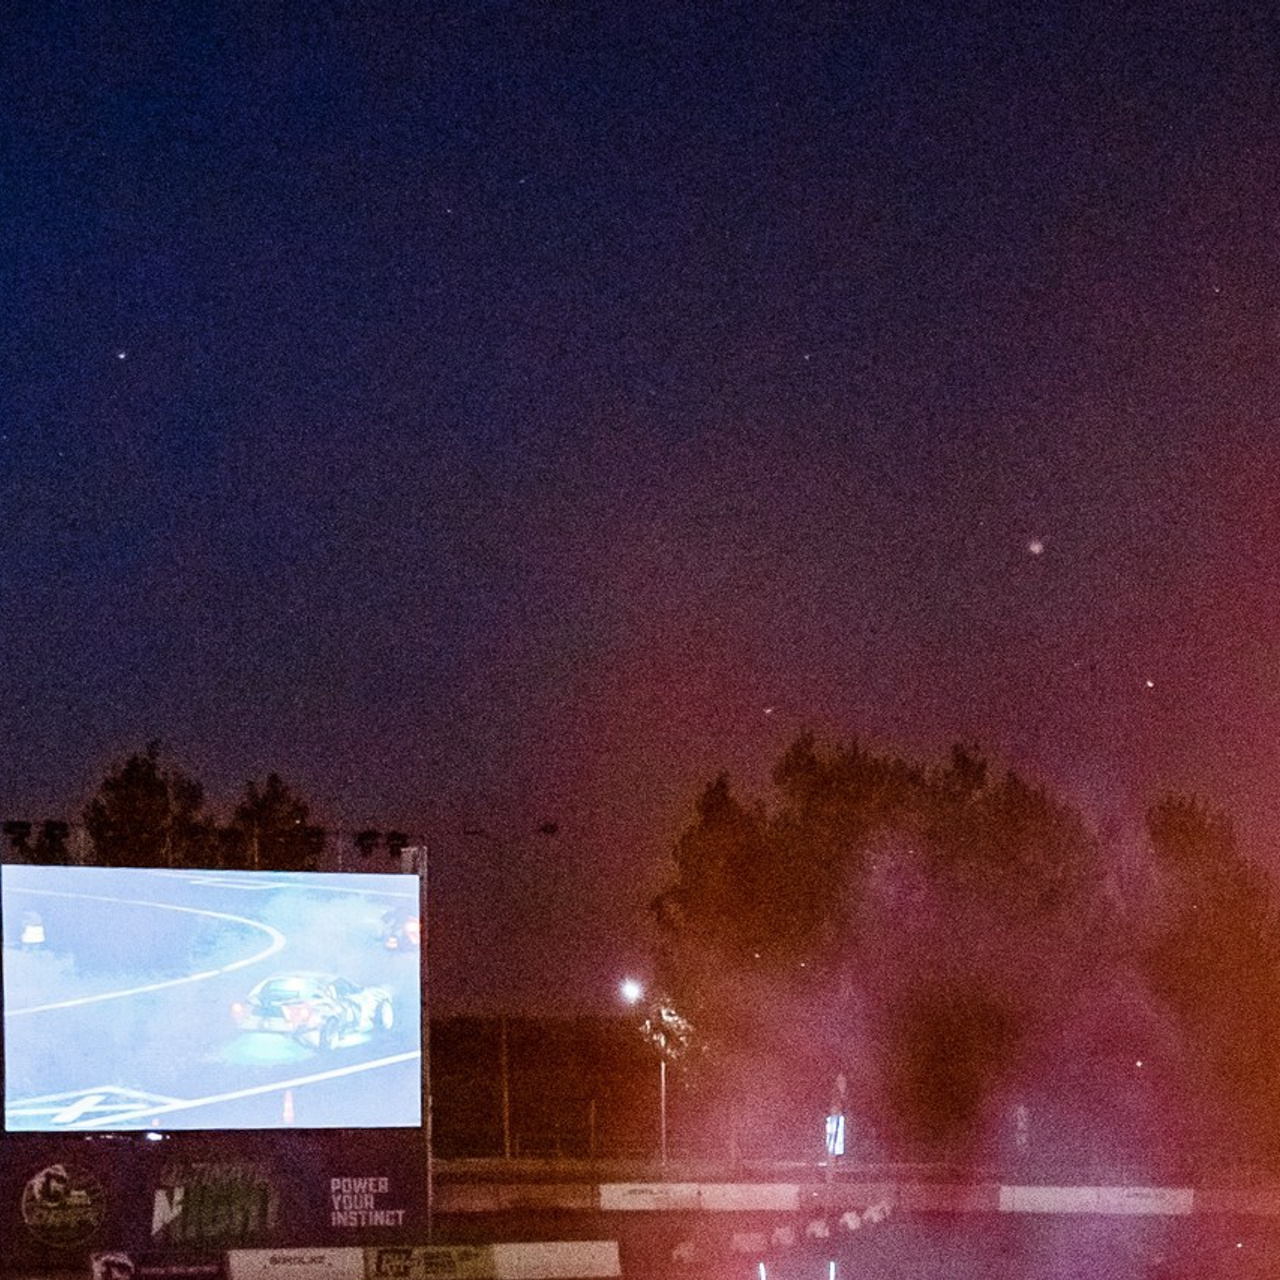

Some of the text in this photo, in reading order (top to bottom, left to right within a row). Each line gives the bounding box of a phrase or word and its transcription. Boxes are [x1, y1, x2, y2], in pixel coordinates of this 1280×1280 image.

[331, 1177, 389, 1194] POWER
[331, 1193, 375, 1210] YOUR
[331, 1210, 405, 1227] INSTINCT
